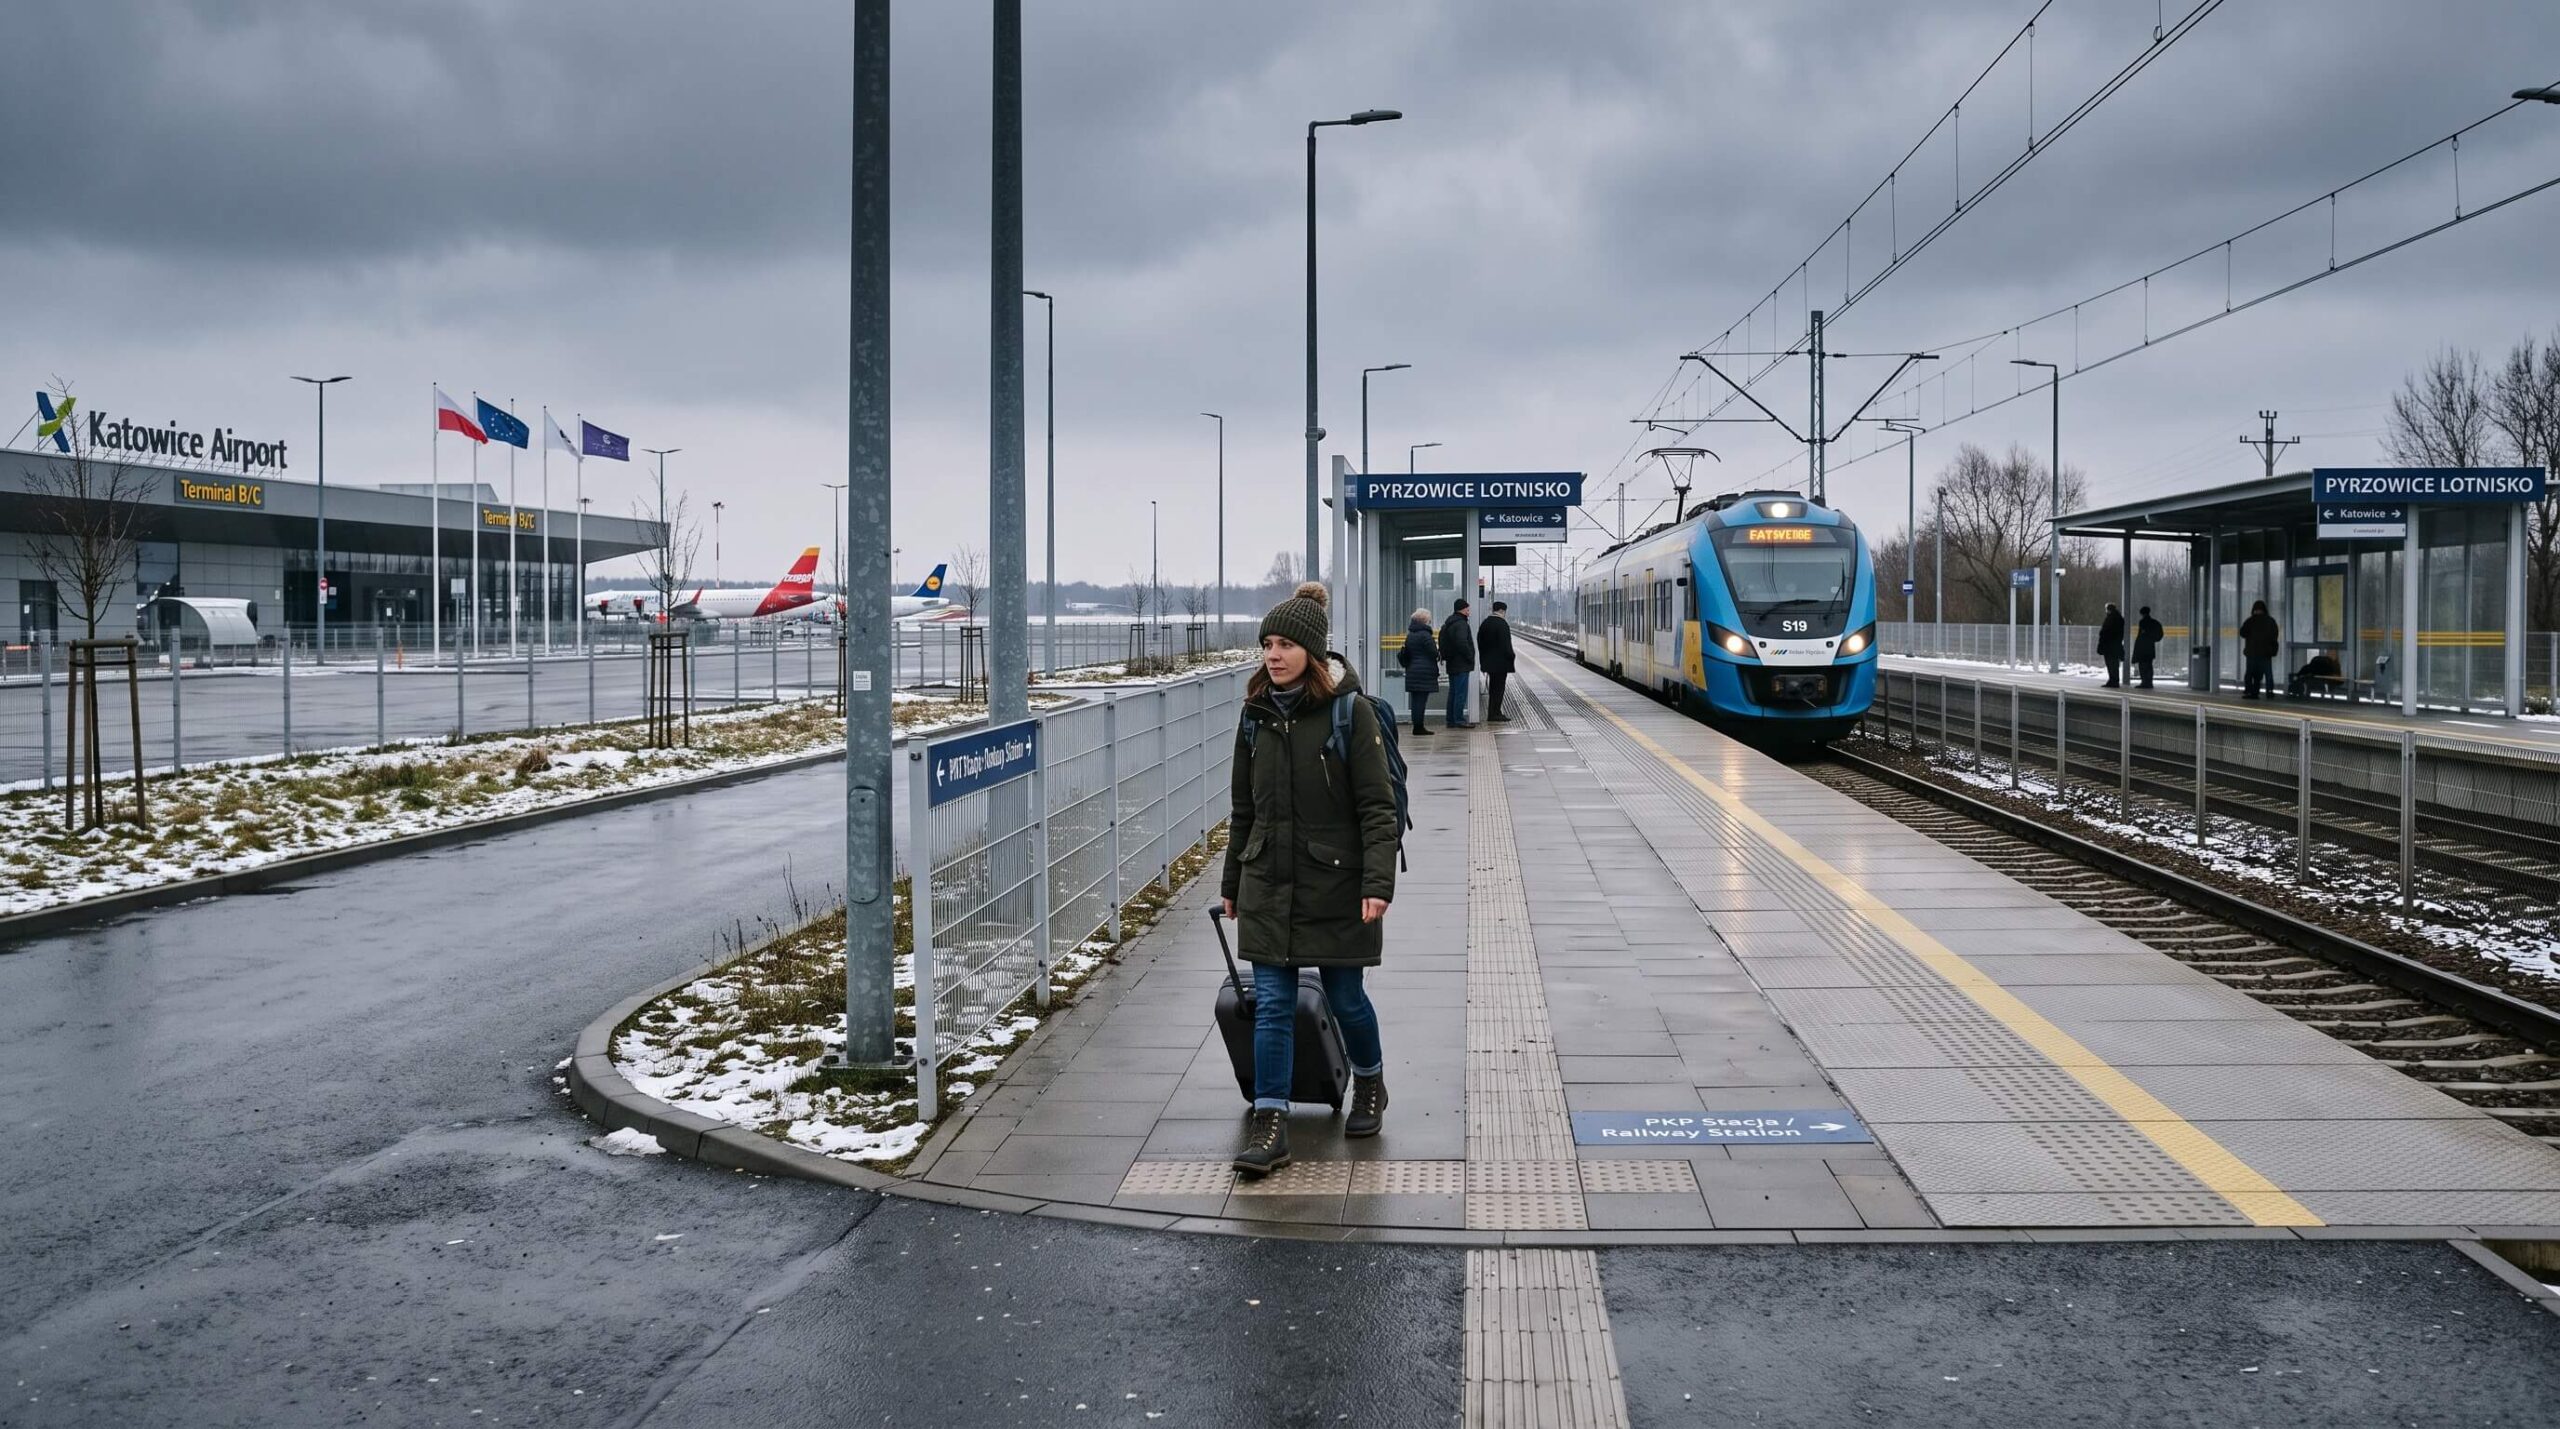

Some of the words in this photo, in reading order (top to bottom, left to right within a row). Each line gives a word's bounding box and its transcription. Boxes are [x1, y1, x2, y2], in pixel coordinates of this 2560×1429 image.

[89, 410, 204, 458] Katowice
[210, 427, 288, 473] Airport
[181, 479, 236, 502] Terminal
[238, 484, 262, 505] B/C
[1368, 483, 1475, 499] PYRZOWICE
[1480, 482, 1571, 498] LOTNISKO
[2325, 477, 2435, 494] PYRZOWICE
[2440, 477, 2534, 494] LOTNISKO
[483, 509, 518, 526] Terminl
[1499, 512, 1544, 523] Katowice
[2340, 508, 2386, 519] Katowice
[1782, 620, 1808, 632] S19
[1645, 1118, 1694, 1127] PKP
[1701, 1117, 1779, 1129] Stacja
[1708, 1127, 1802, 1137] Station
